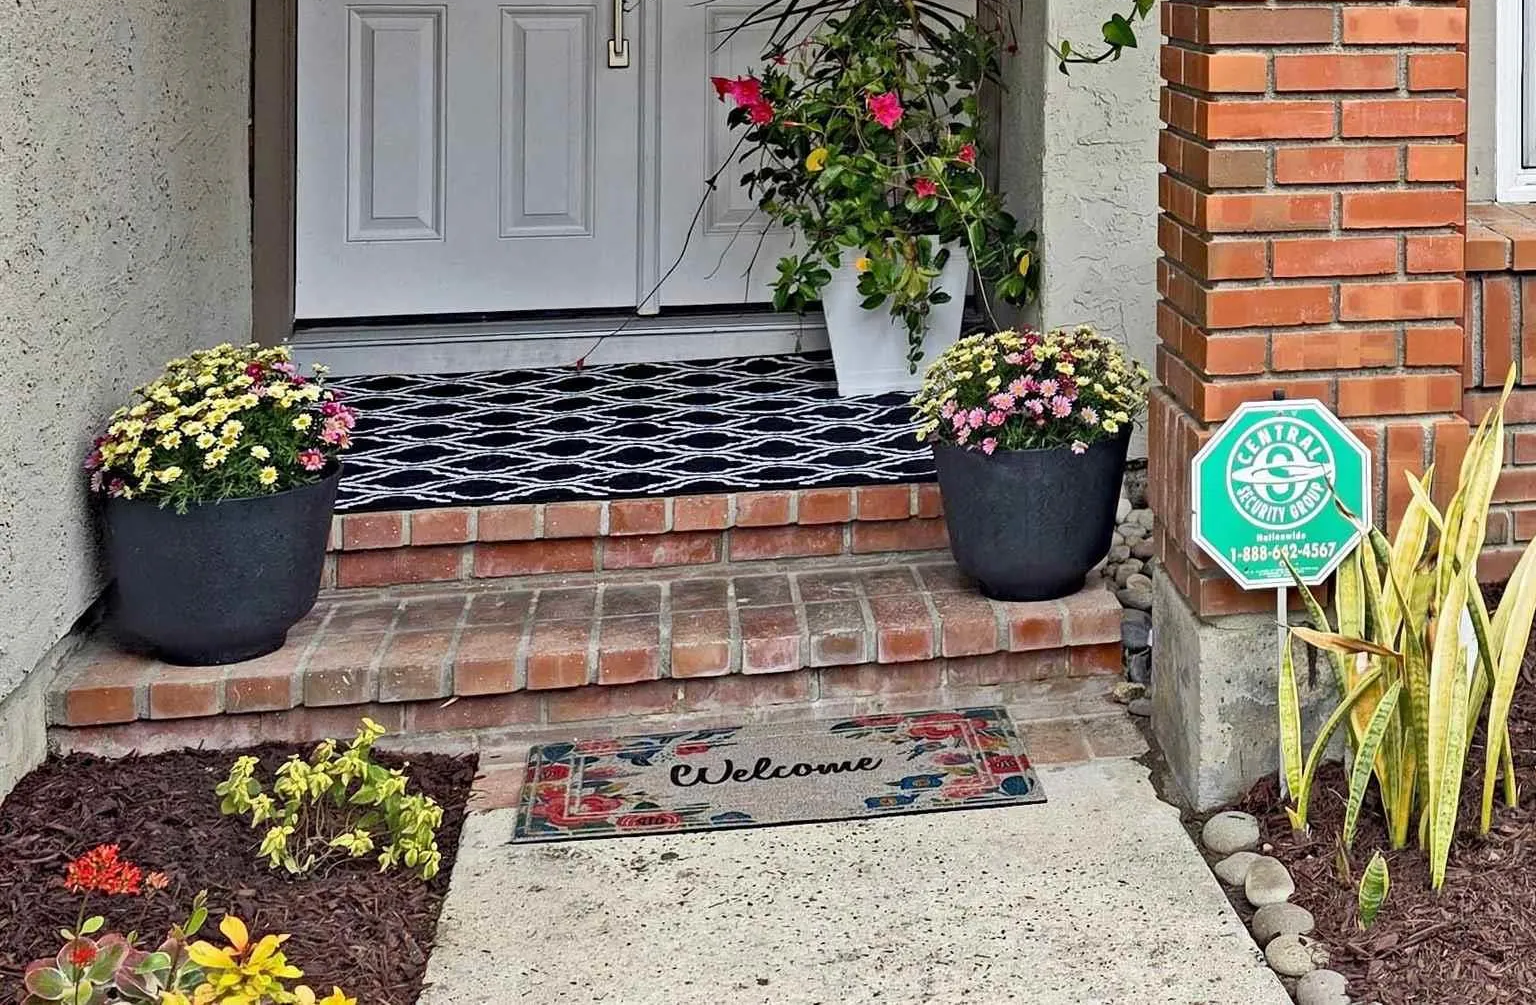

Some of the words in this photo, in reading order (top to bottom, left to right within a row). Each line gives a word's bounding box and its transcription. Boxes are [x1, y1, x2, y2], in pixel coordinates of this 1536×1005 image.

[1237, 424, 1323, 465] CENTRAL
[1236, 484, 1285, 523] SECURITY
[1290, 481, 1326, 520] GROUP
[1256, 530, 1307, 543] Nationwide
[670, 757, 883, 787] Welcome
